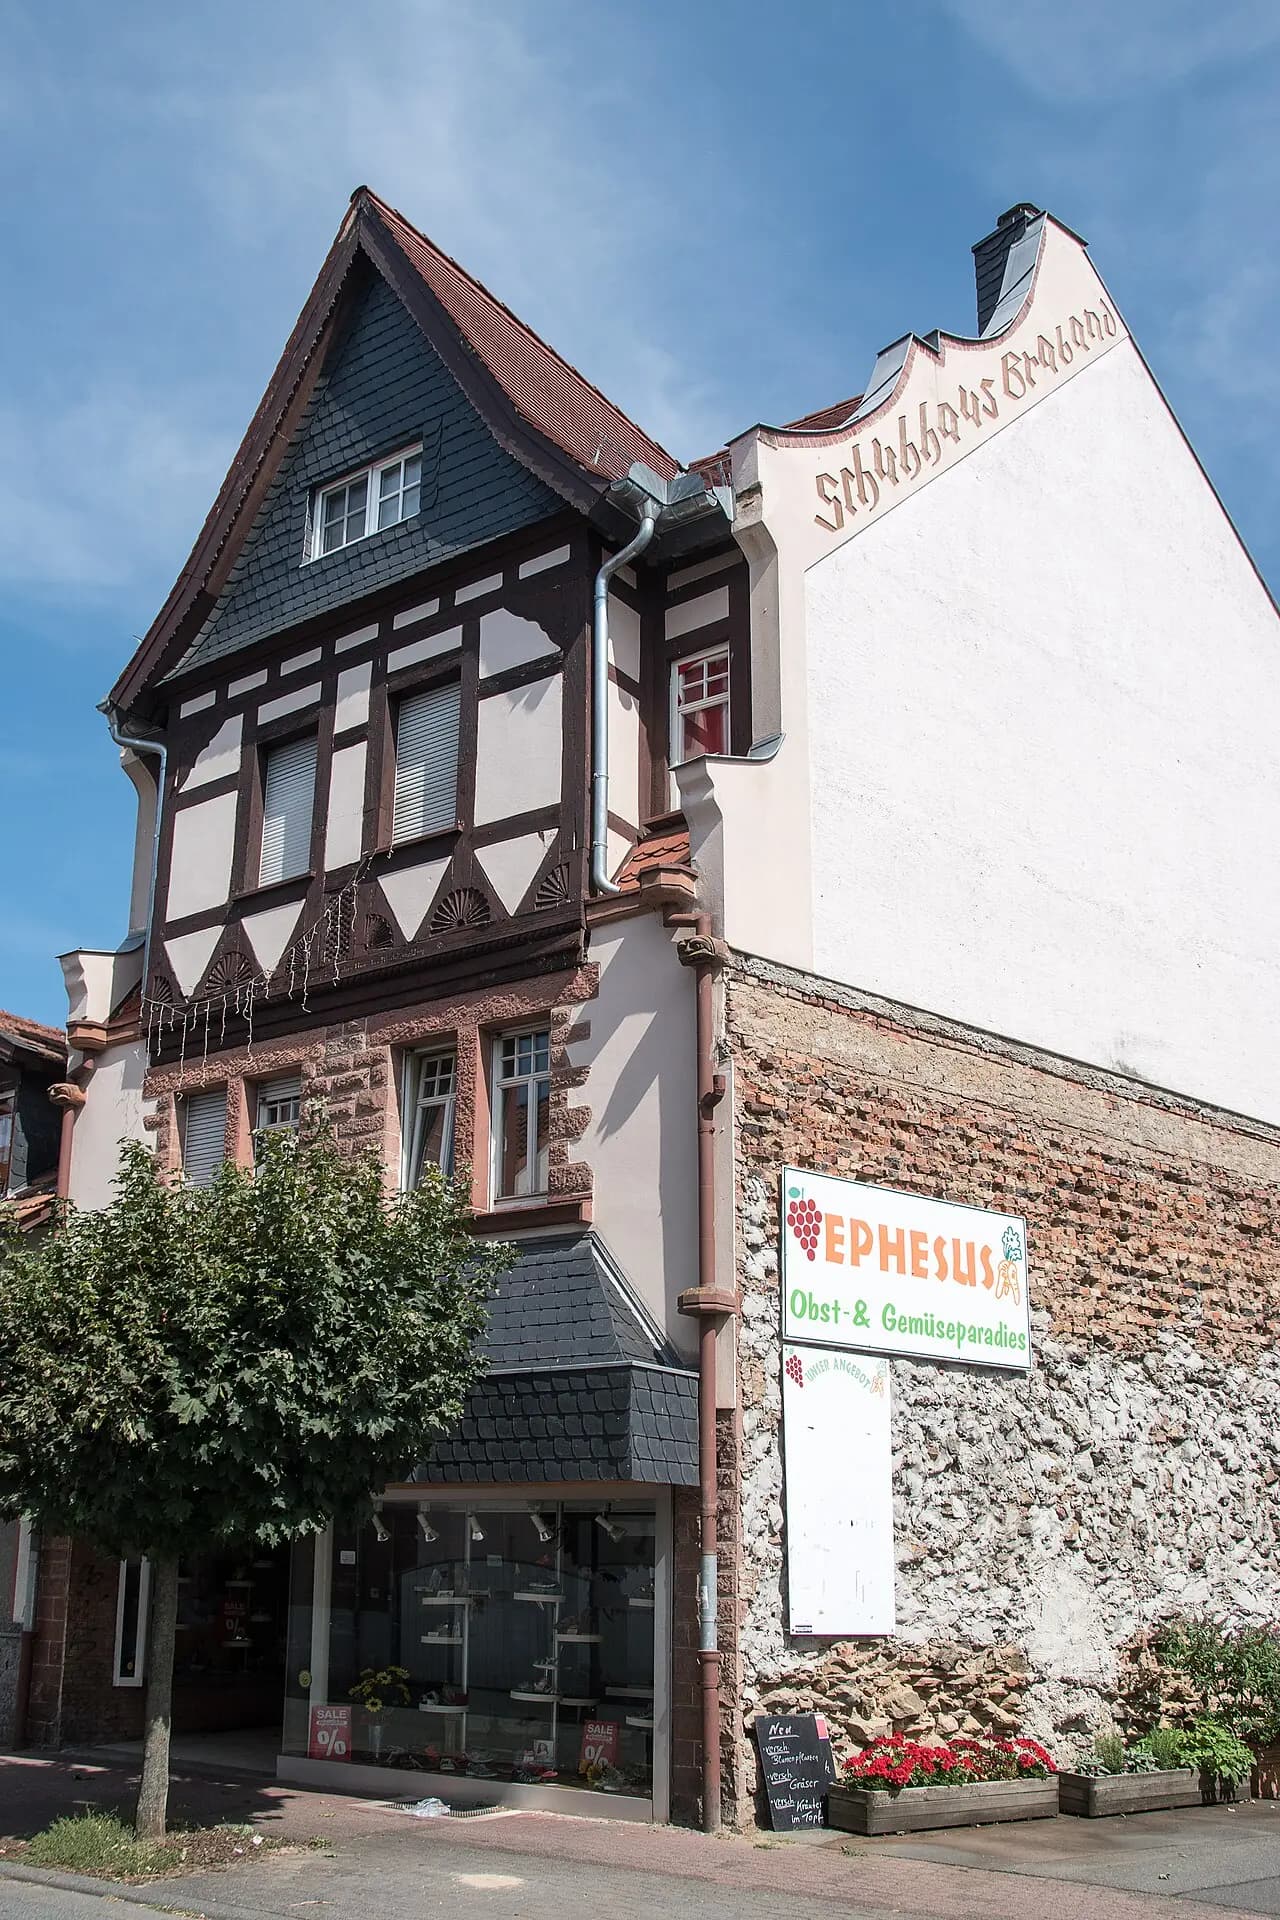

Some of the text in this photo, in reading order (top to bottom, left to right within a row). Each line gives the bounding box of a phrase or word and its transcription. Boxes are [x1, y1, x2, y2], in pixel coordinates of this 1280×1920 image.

[814, 378, 999, 532] Schuhhaus
[824, 1212, 995, 1290] EPHESUS
[881, 1302, 1026, 1350] Gemüseparadies
[833, 1357, 871, 1388] ANGEBOT
[317, 1710, 347, 1719] SALE
[587, 1723, 613, 1735] SALE
[769, 1722, 792, 1736] Neu
[789, 1778, 819, 1790] Gräser
[791, 1809, 824, 1824] im Topf
